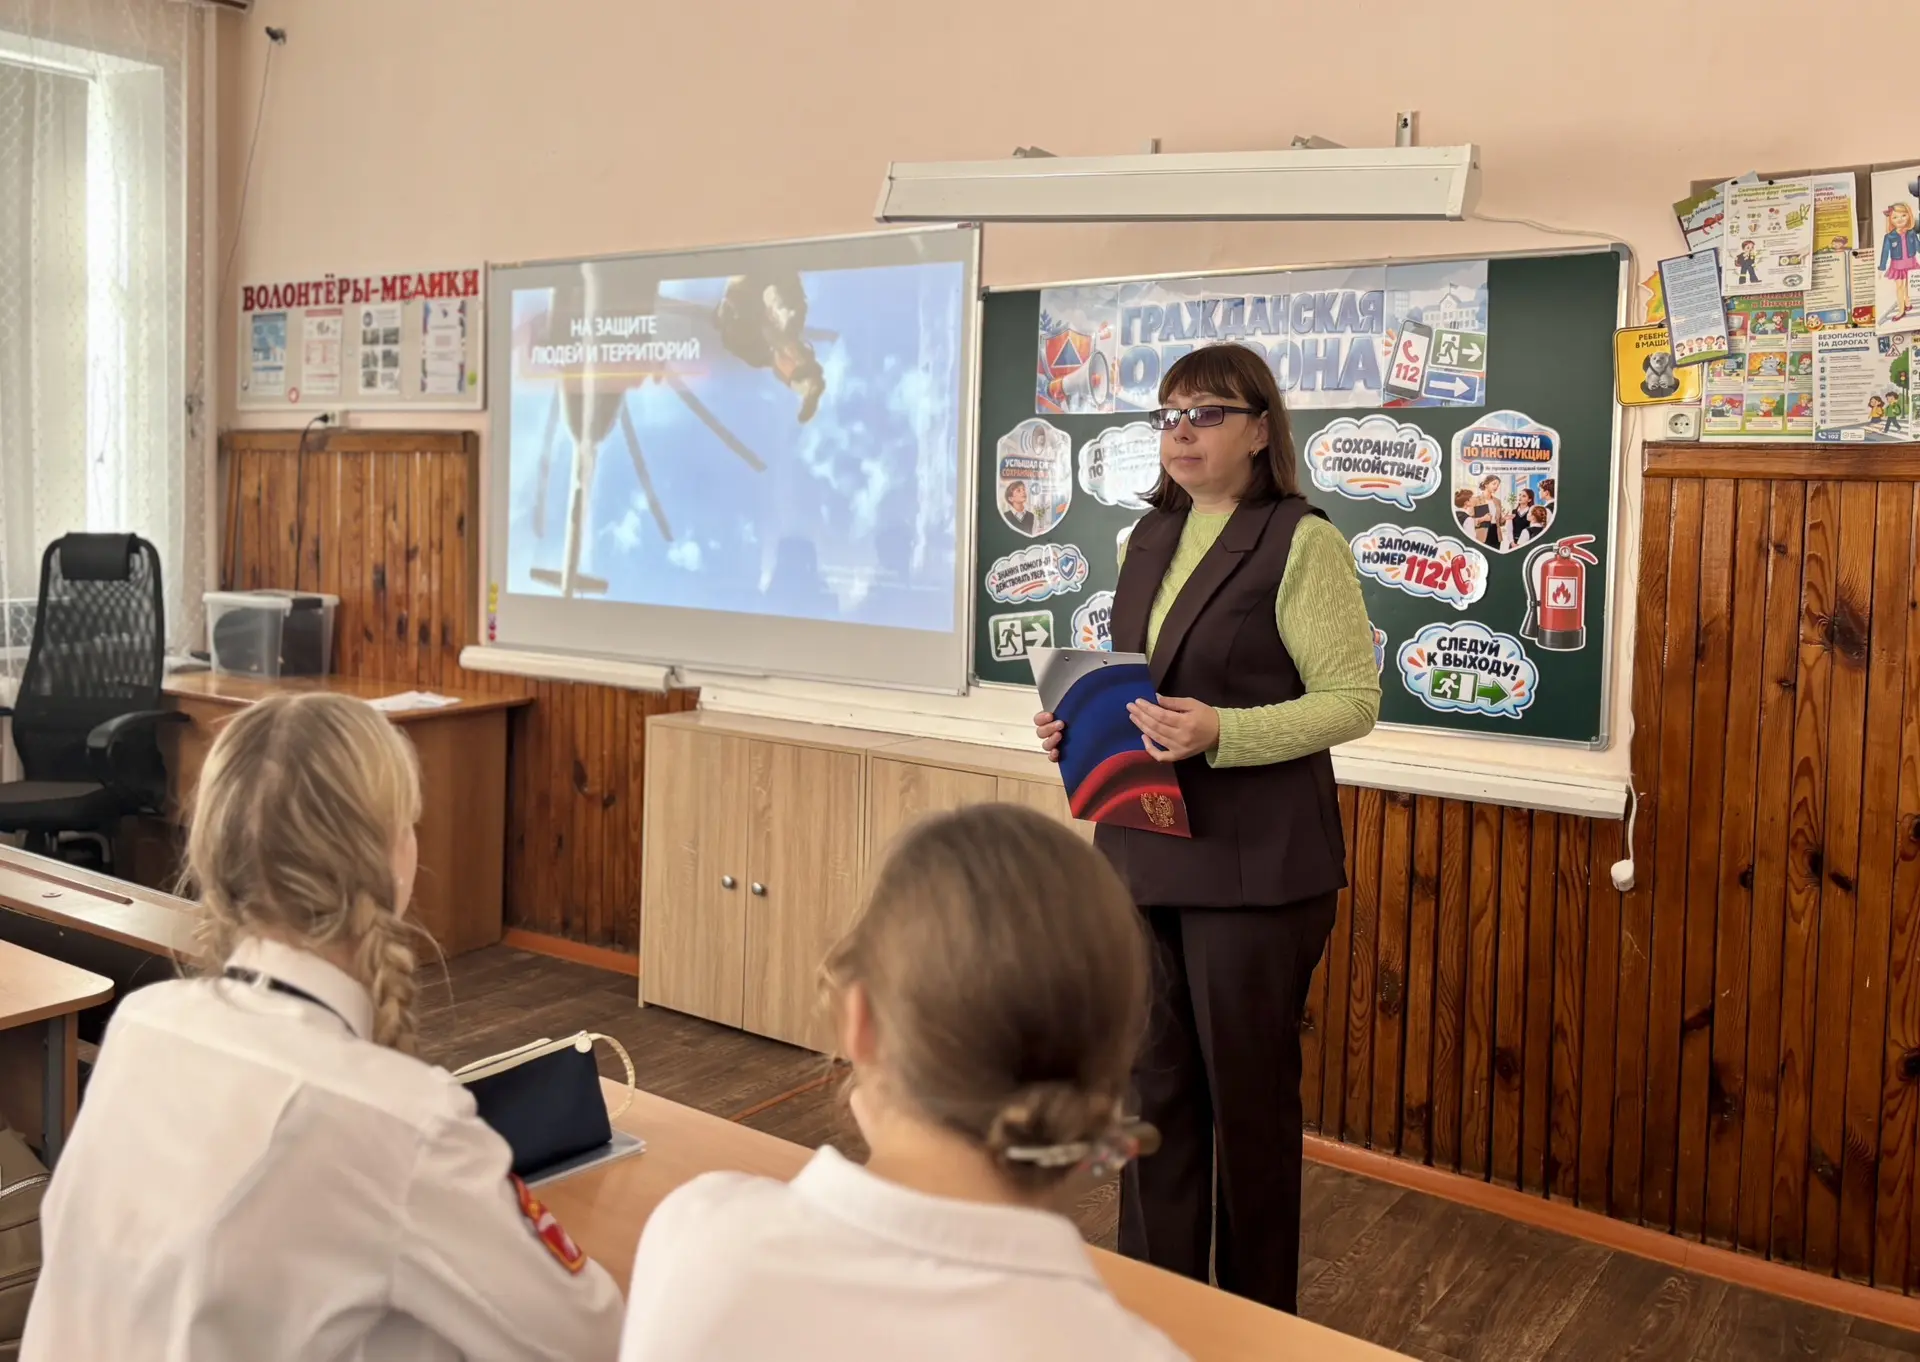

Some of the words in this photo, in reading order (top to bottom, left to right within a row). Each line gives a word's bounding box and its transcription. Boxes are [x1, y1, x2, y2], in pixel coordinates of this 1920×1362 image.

[241, 269, 480, 312] ВОЛОНТЁРЫ-МЕДИКИ
[570, 316, 593, 338] НА
[595, 315, 659, 338] ЗАЩИТЕ
[1120, 290, 1385, 346] ГРАЖДАНСКАЯ
[1638, 331, 1670, 341] РЕБЕНО
[1641, 338, 1669, 348] МАШИ
[1818, 331, 1878, 341] БЕЗОПАСНОСТЬ
[1818, 340, 1830, 348] НА
[1831, 339, 1869, 348] ДОРОГАХ
[531, 341, 584, 367] ЛЮДЕЙ
[586, 344, 599, 364] И
[600, 336, 702, 364] ТЕРРИТОРИЙ
[1119, 336, 1383, 391] ООНА
[1395, 362, 1420, 383] 112
[1331, 437, 1417, 460] СОХРАНЯЙ
[1470, 432, 1541, 450] ДЕЙСТВУЙ
[1463, 446, 1479, 457] ПО
[1481, 447, 1550, 461] ИНСТРУКЦИИ
[1322, 456, 1429, 482] СПОКОЙСТВИЕ!
[1377, 536, 1439, 558] ЗАПОМНИ
[997, 565, 1019, 581] ЗНАНИЯ
[1361, 550, 1407, 566] НОМЕР
[1404, 555, 1453, 591] 112!
[996, 573, 1031, 594] ДЕЙСТВОВАТЬ
[1436, 636, 1501, 657] СЛЕДУЙ
[1426, 652, 1438, 666] К
[1442, 652, 1520, 681] ВЫХОДУ!
